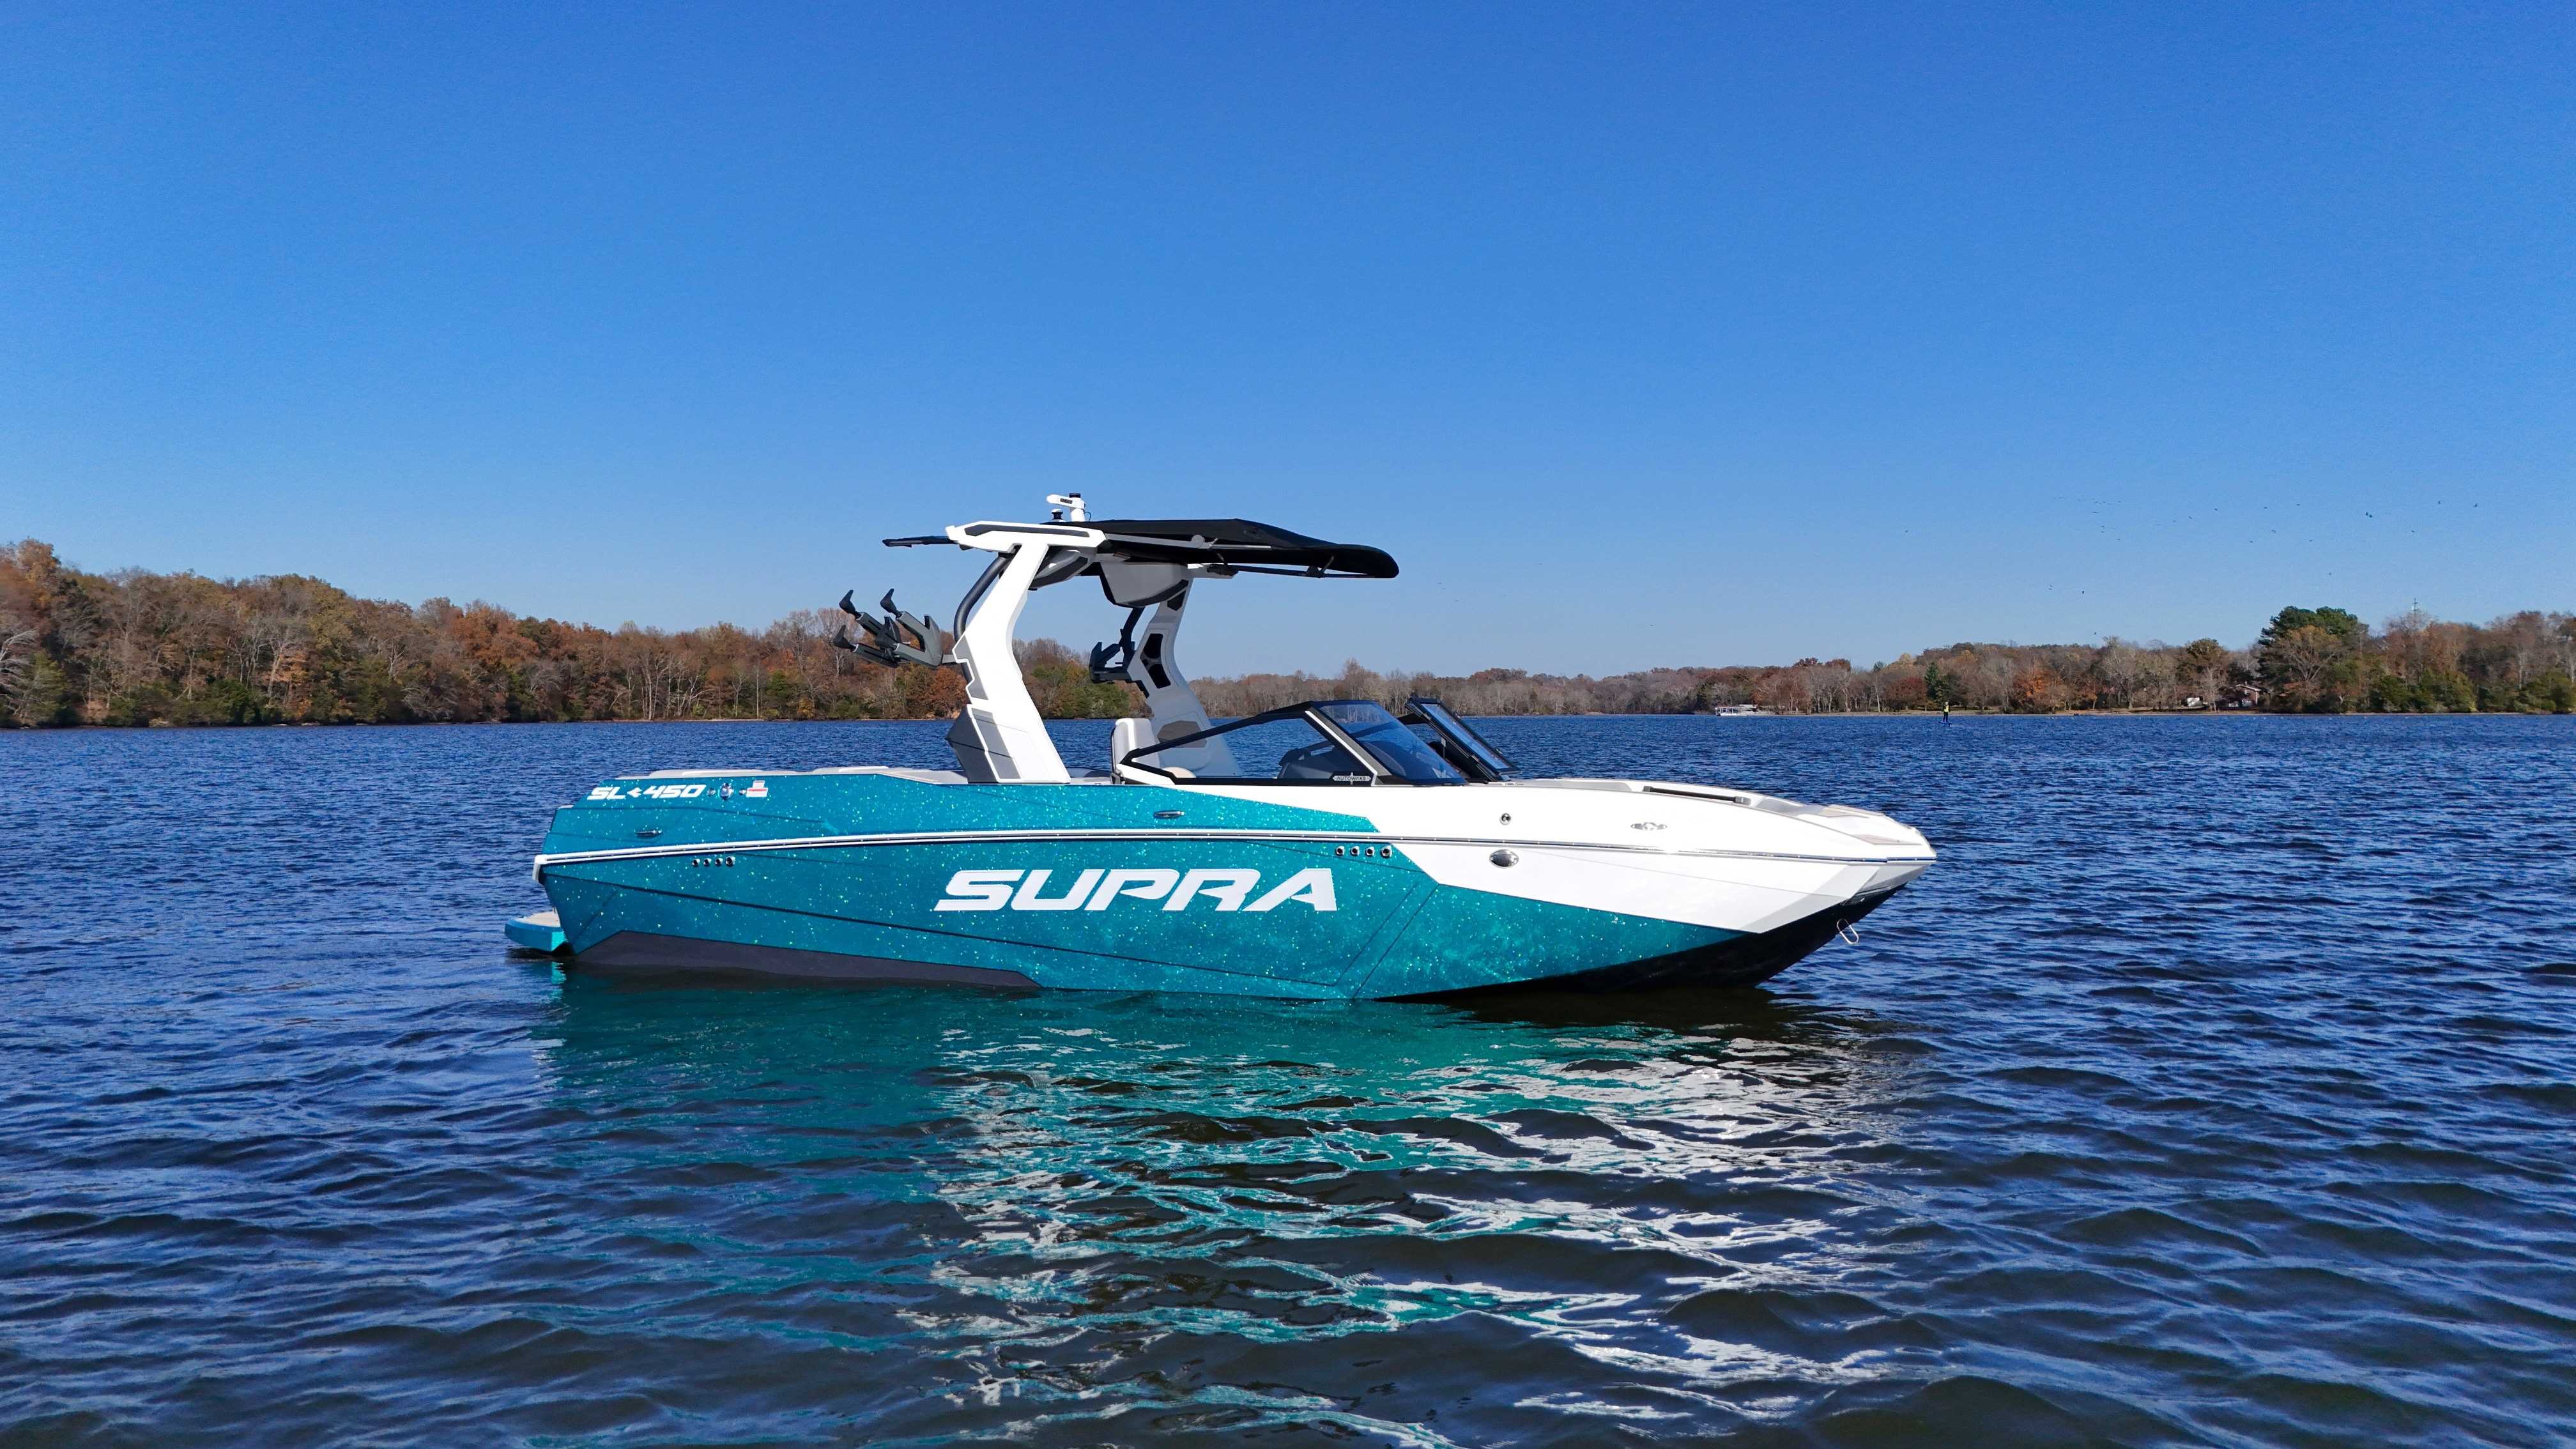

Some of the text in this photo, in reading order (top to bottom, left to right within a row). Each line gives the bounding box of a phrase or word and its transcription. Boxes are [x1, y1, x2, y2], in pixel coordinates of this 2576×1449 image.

[587, 785, 707, 800] SL 450
[933, 868, 1337, 912] SUPRA
